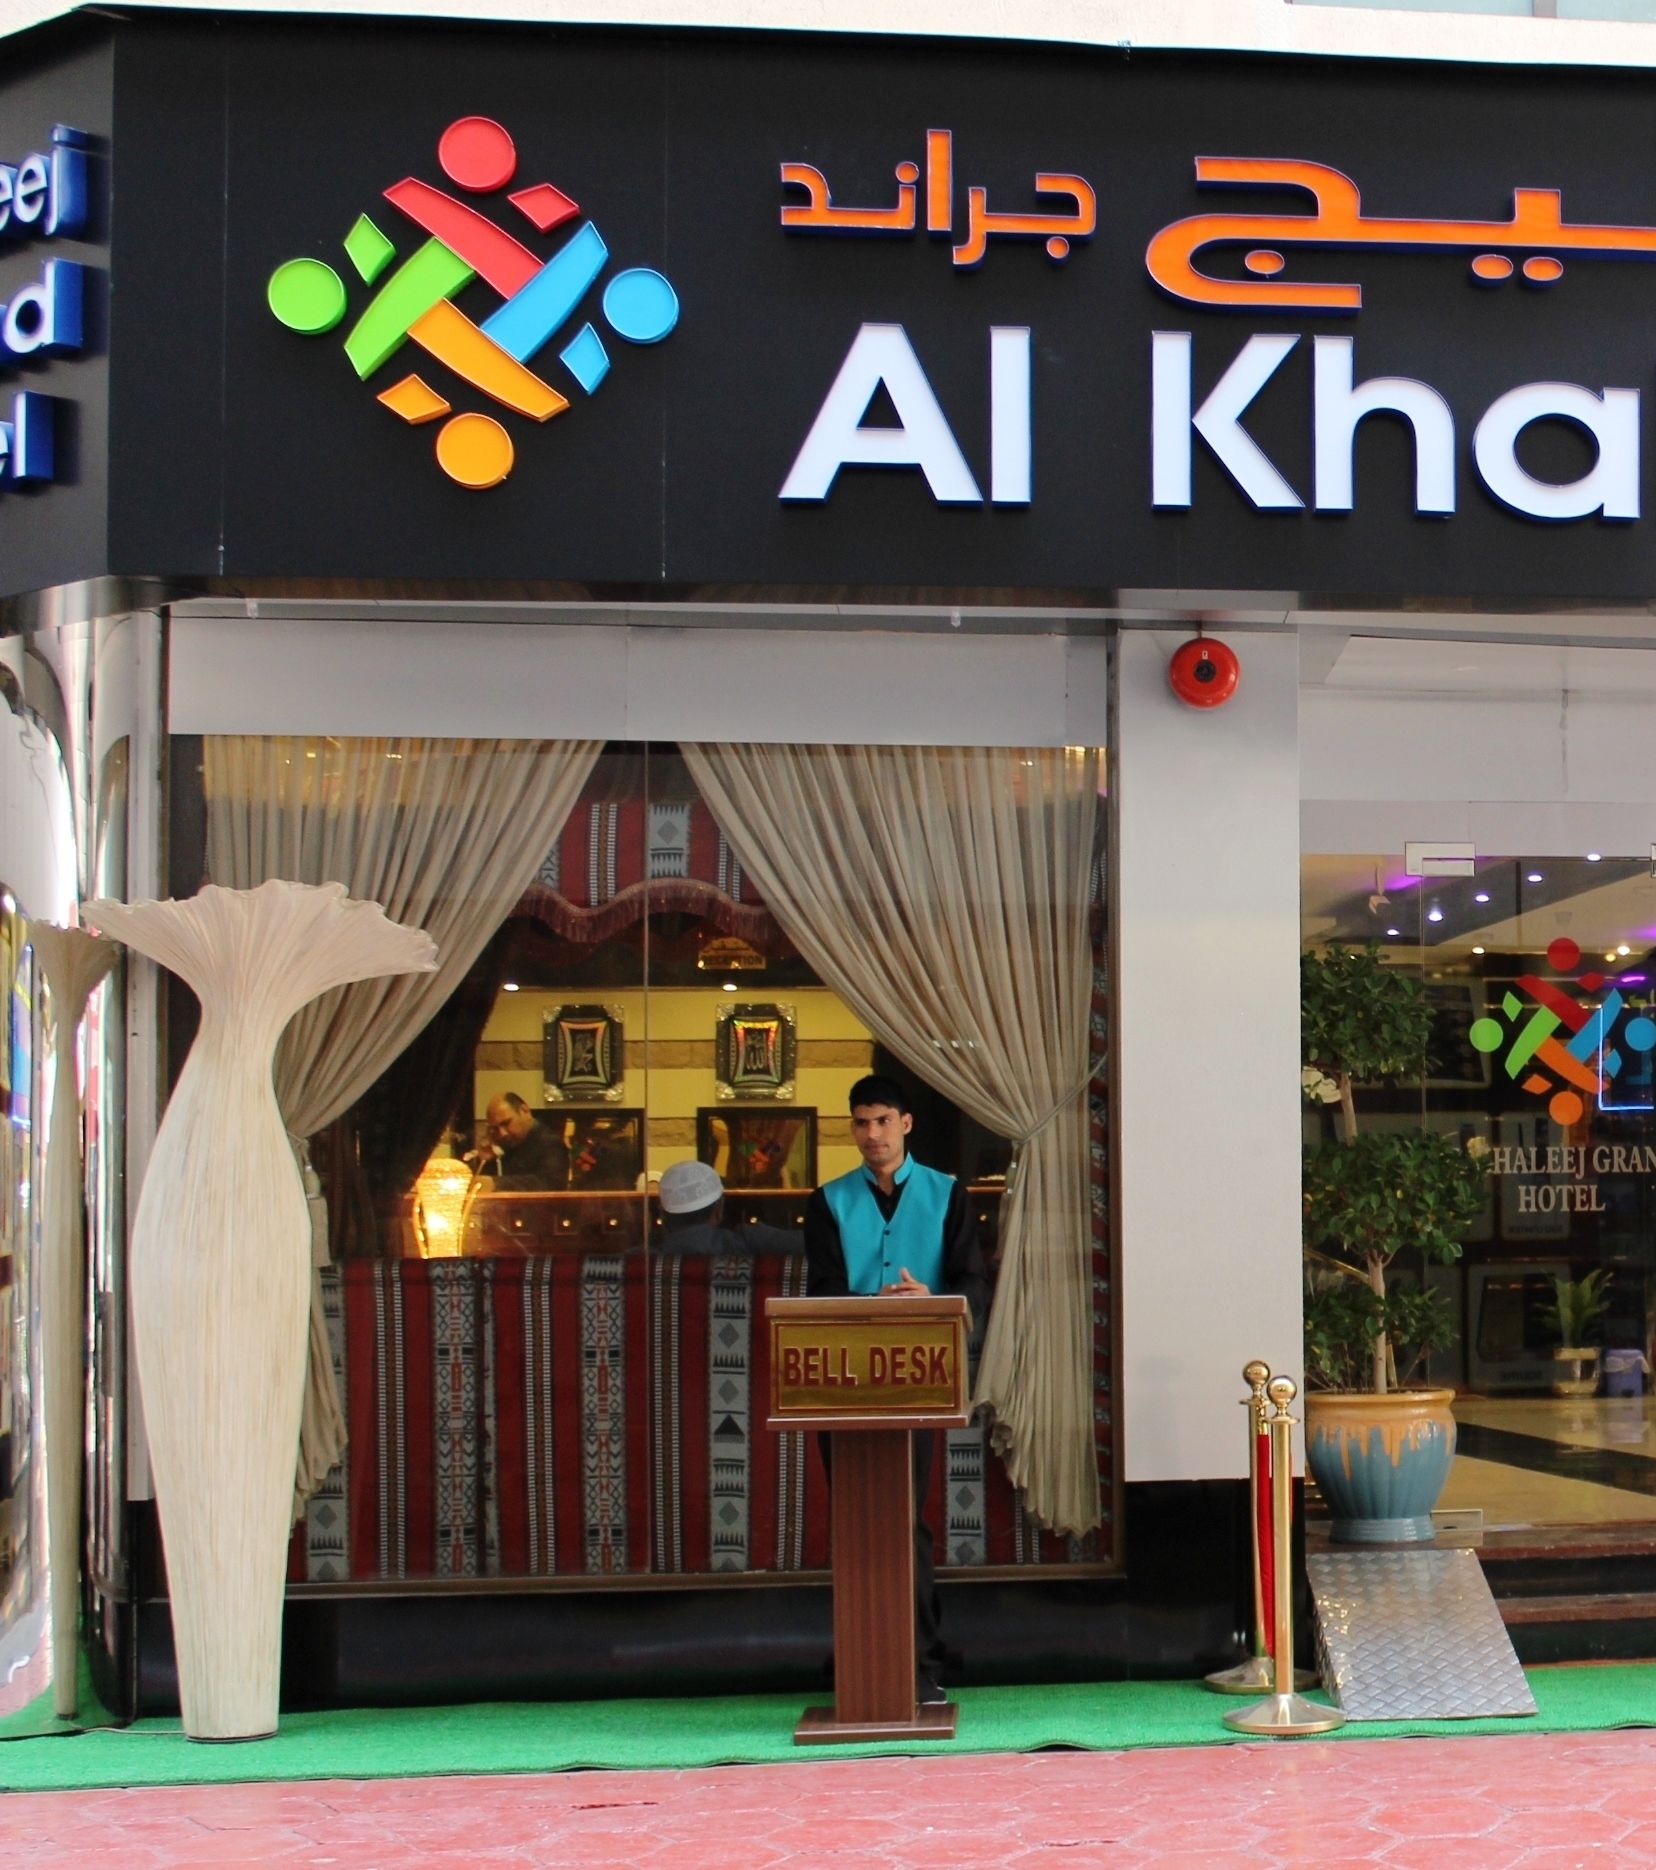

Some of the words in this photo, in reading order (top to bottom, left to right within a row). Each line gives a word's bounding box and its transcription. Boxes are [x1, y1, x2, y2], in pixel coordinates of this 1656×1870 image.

[780, 128, 1096, 267] جراند
[778, 322, 1031, 504] Al
[1487, 1146, 1586, 1180] HALEEJ
[1518, 1184, 1606, 1213] HOTEL
[783, 1346, 859, 1387] BELL
[869, 1344, 950, 1386] DESK
